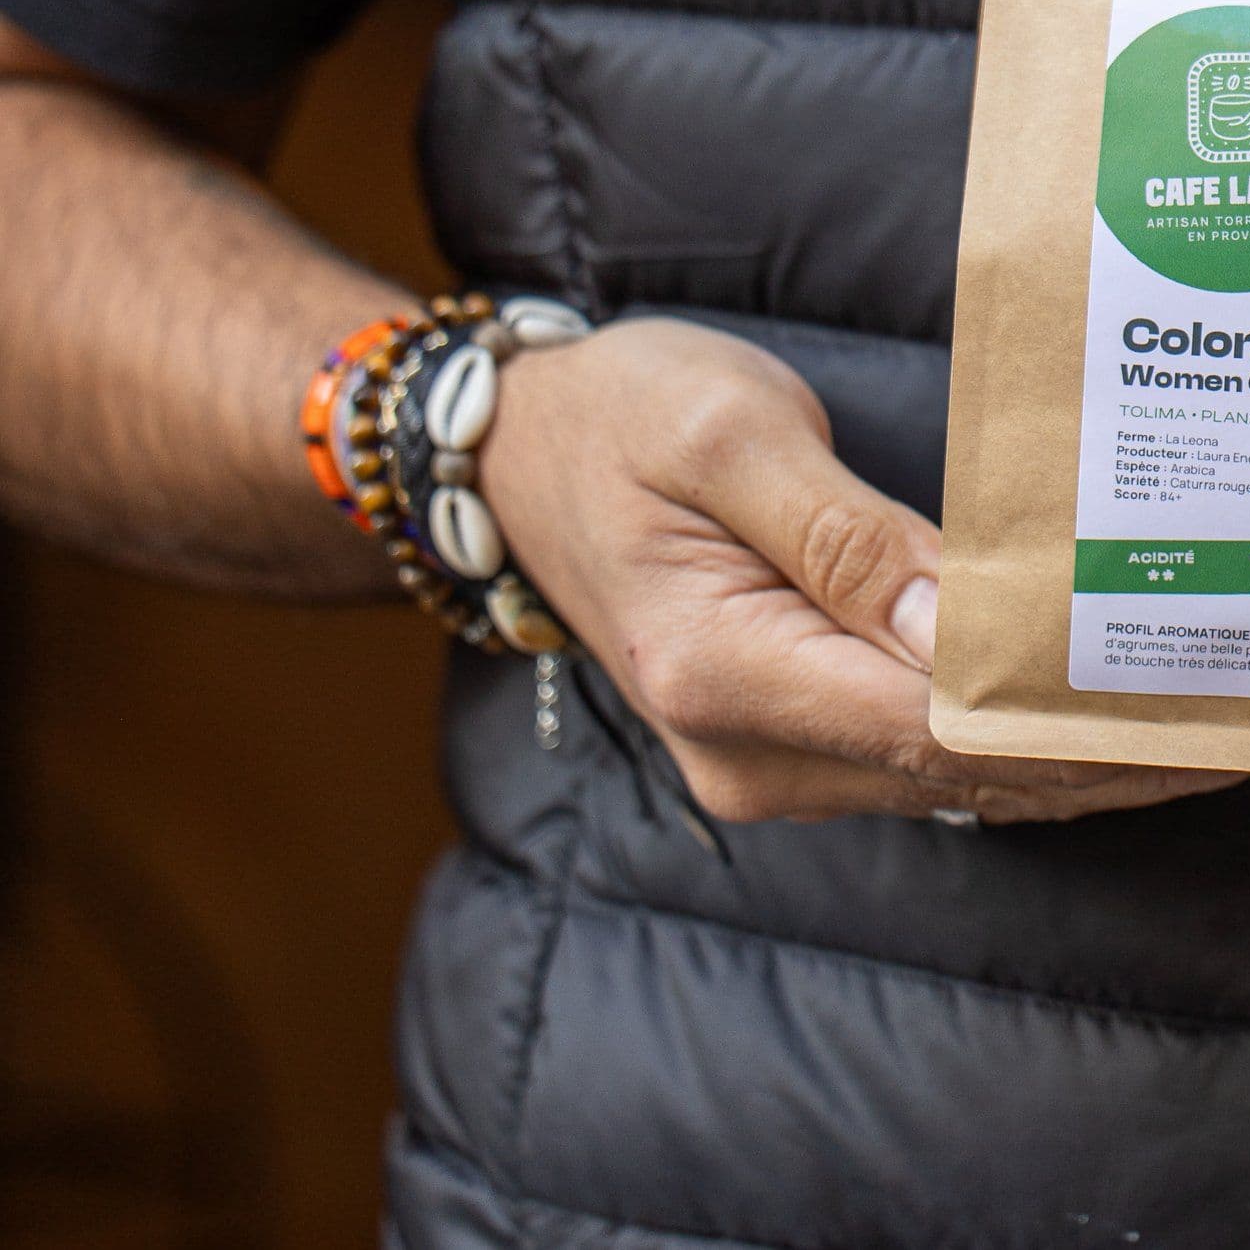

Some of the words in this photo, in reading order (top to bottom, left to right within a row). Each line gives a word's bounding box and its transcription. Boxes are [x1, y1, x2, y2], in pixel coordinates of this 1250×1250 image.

[1145, 176, 1221, 207] CAFE
[1147, 216, 1209, 228] ARTISAN
[1188, 231, 1206, 242] EN
[1120, 363, 1243, 392] Women
[1119, 404, 1187, 420] TOLIMA
[1118, 431, 1155, 443] Ferme
[1166, 434, 1180, 444] La
[1183, 435, 1219, 447] Leona
[1117, 446, 1187, 459] Producteur
[1197, 451, 1230, 462] Laura
[1171, 463, 1216, 476] Arabica
[1115, 474, 1160, 487] Variété
[1170, 477, 1216, 490] Caturra
[1114, 488, 1150, 501] Score
[1160, 491, 1182, 501] 84+
[1128, 550, 1195, 565] ACIDITÉ
[1106, 622, 1154, 636] PROFIL
[1158, 626, 1250, 641] AROMATIQUE
[1182, 643, 1207, 652] une
[1211, 643, 1243, 655] belle
[1104, 653, 1121, 665] de
[1125, 654, 1175, 668] bouche
